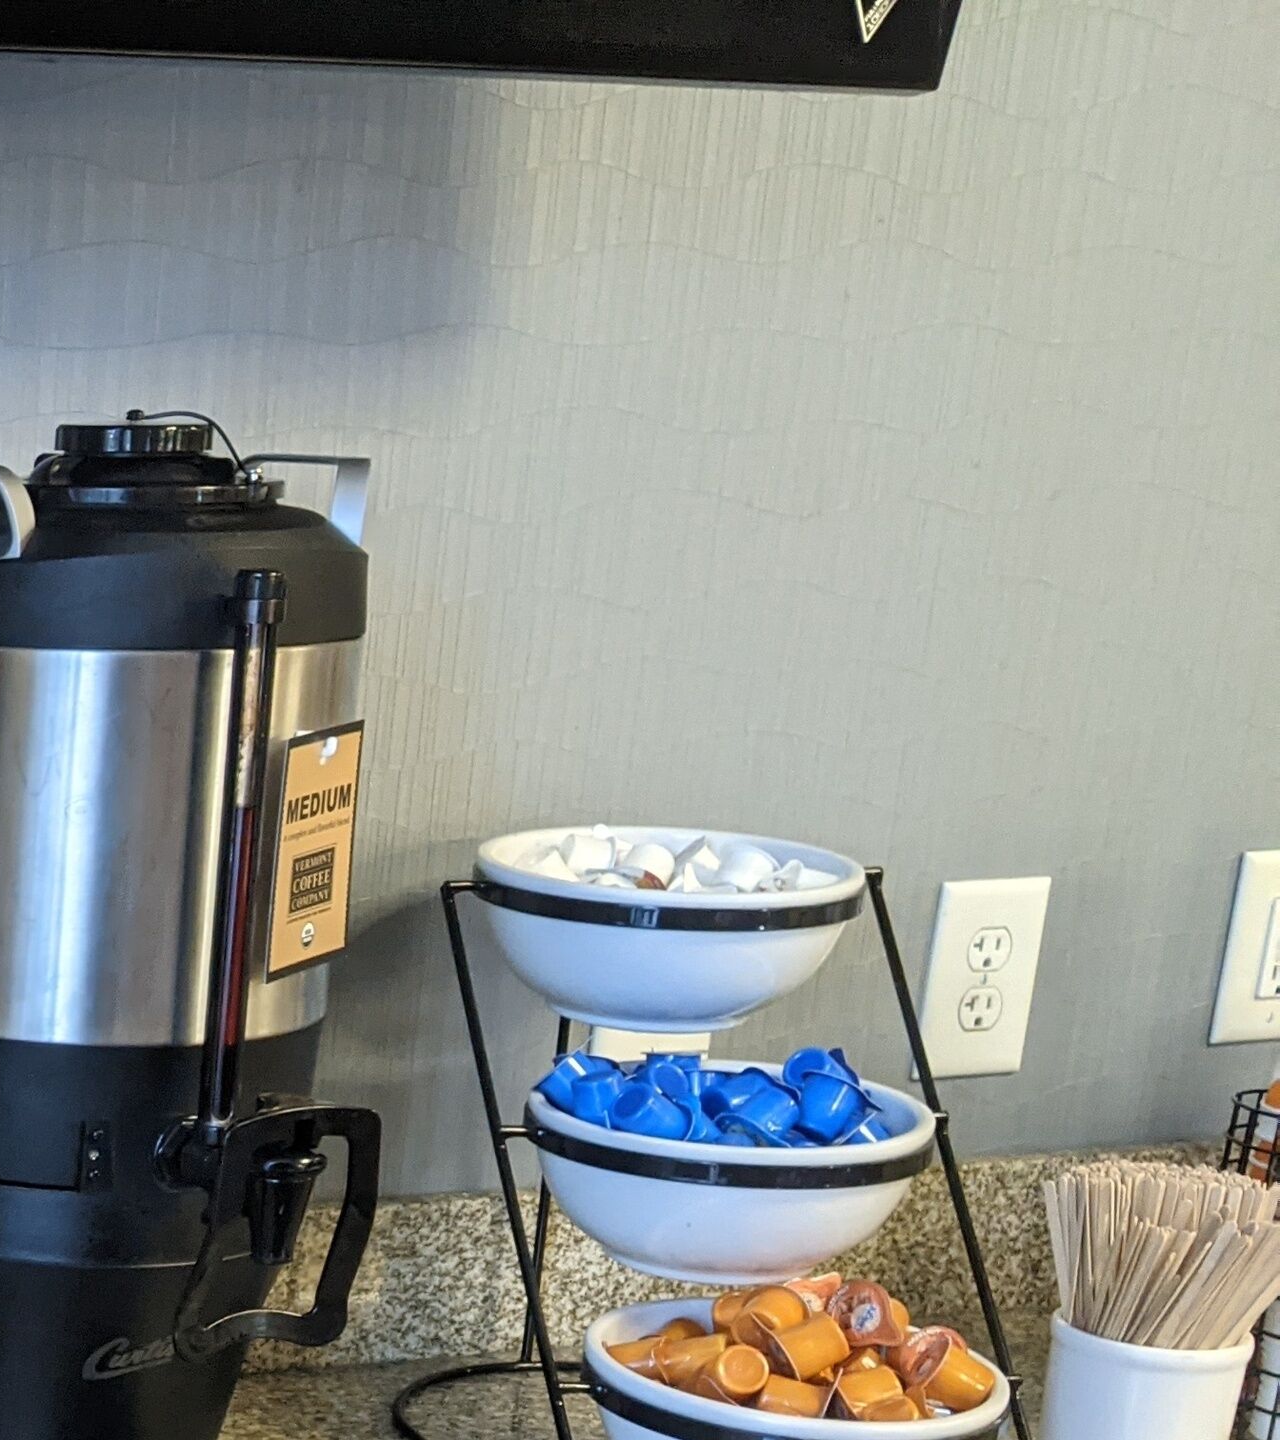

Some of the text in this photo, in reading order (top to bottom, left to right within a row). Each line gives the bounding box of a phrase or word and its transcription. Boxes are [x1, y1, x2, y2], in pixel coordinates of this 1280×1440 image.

[286, 783, 352, 825] MEDIUM
[294, 852, 333, 872] VERMONT
[293, 869, 330, 893] COFFEE
[291, 889, 330, 911] COMPANY
